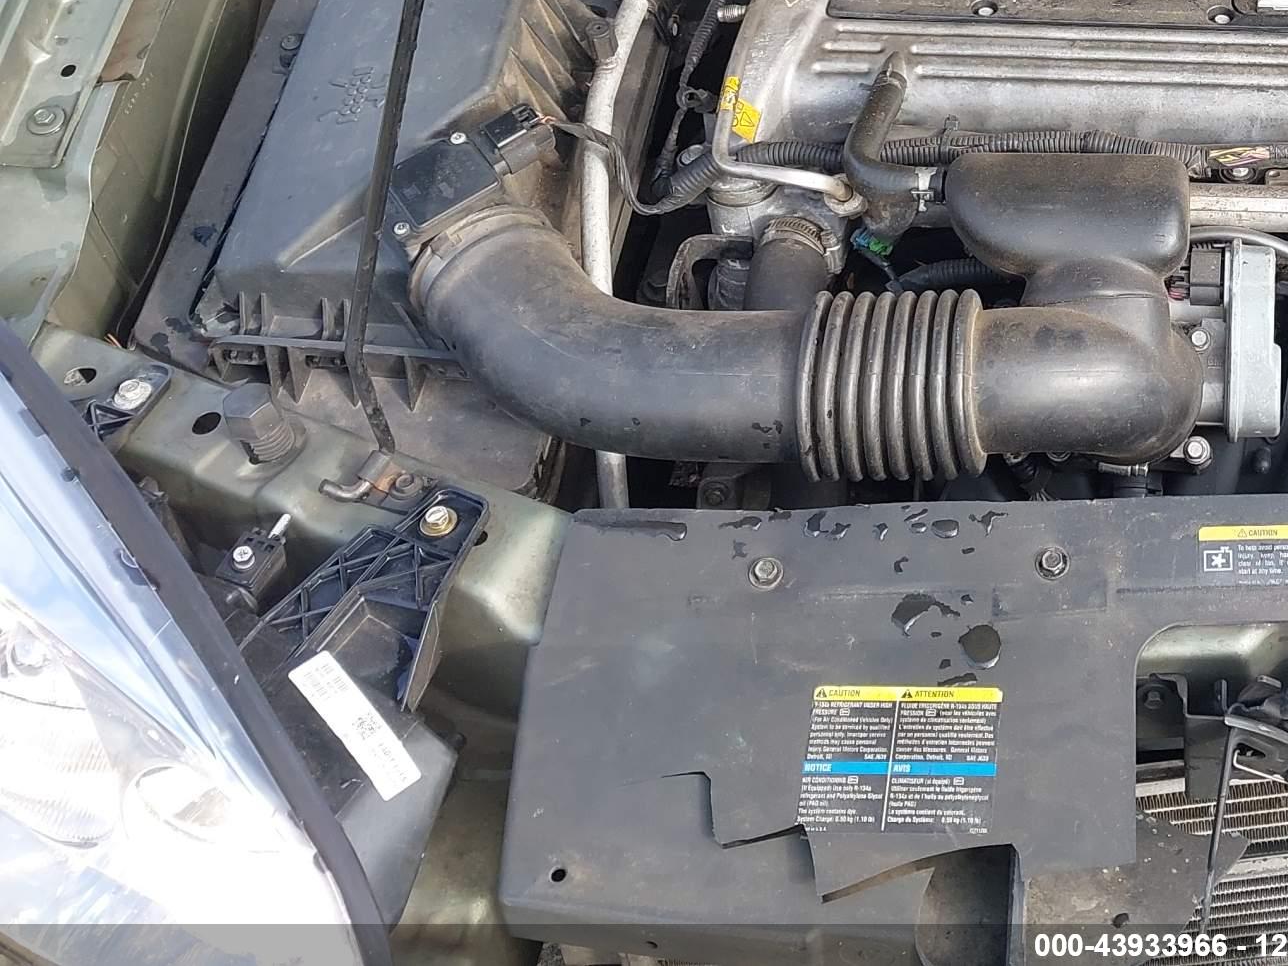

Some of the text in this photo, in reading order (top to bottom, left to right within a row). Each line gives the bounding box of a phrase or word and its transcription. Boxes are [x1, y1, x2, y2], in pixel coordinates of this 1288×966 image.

[1248, 529, 1278, 537] CAUTION
[828, 689, 861, 697] CAUTION
[914, 690, 955, 698] ATTENTION
[804, 763, 833, 772] NOTICE
[893, 764, 911, 773] AVIS
